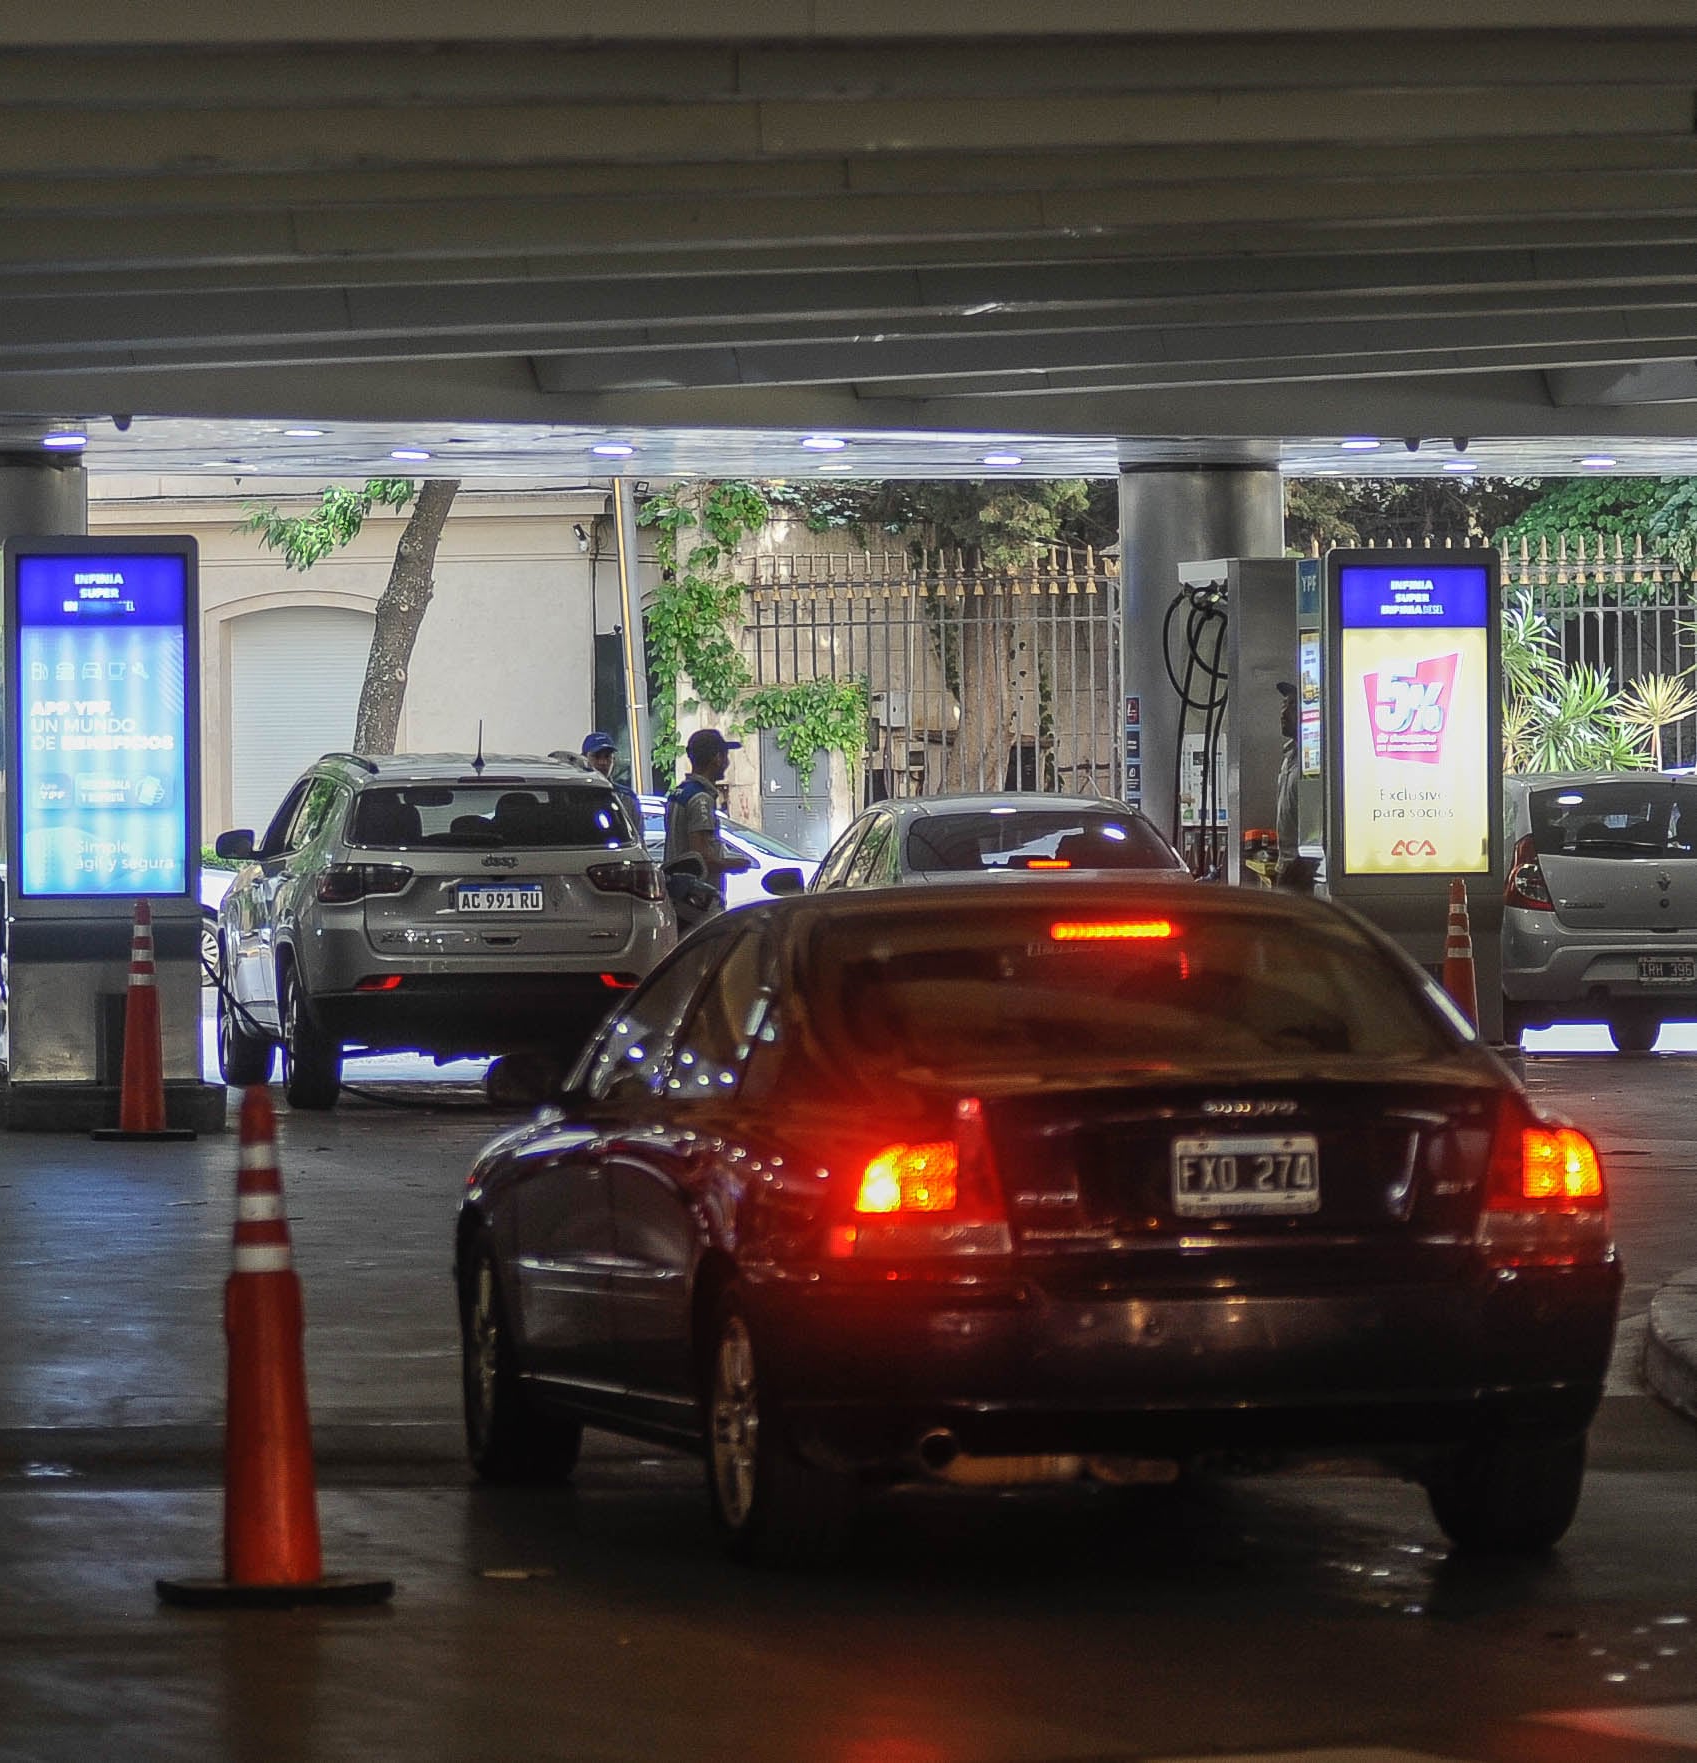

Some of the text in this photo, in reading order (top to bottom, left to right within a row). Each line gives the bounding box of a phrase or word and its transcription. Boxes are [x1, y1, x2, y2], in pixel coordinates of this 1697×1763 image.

[74, 573, 124, 585] INFINIA
[1302, 576, 1317, 592] YPF
[79, 588, 120, 598] SUPER
[30, 718, 135, 733] UN MUNDO
[30, 736, 56, 750] DE
[1373, 808, 1405, 821] para
[461, 893, 540, 909] AC 991 RU
[1641, 963, 1693, 977] IRH 396
[1256, 1155, 1314, 1192] 274
